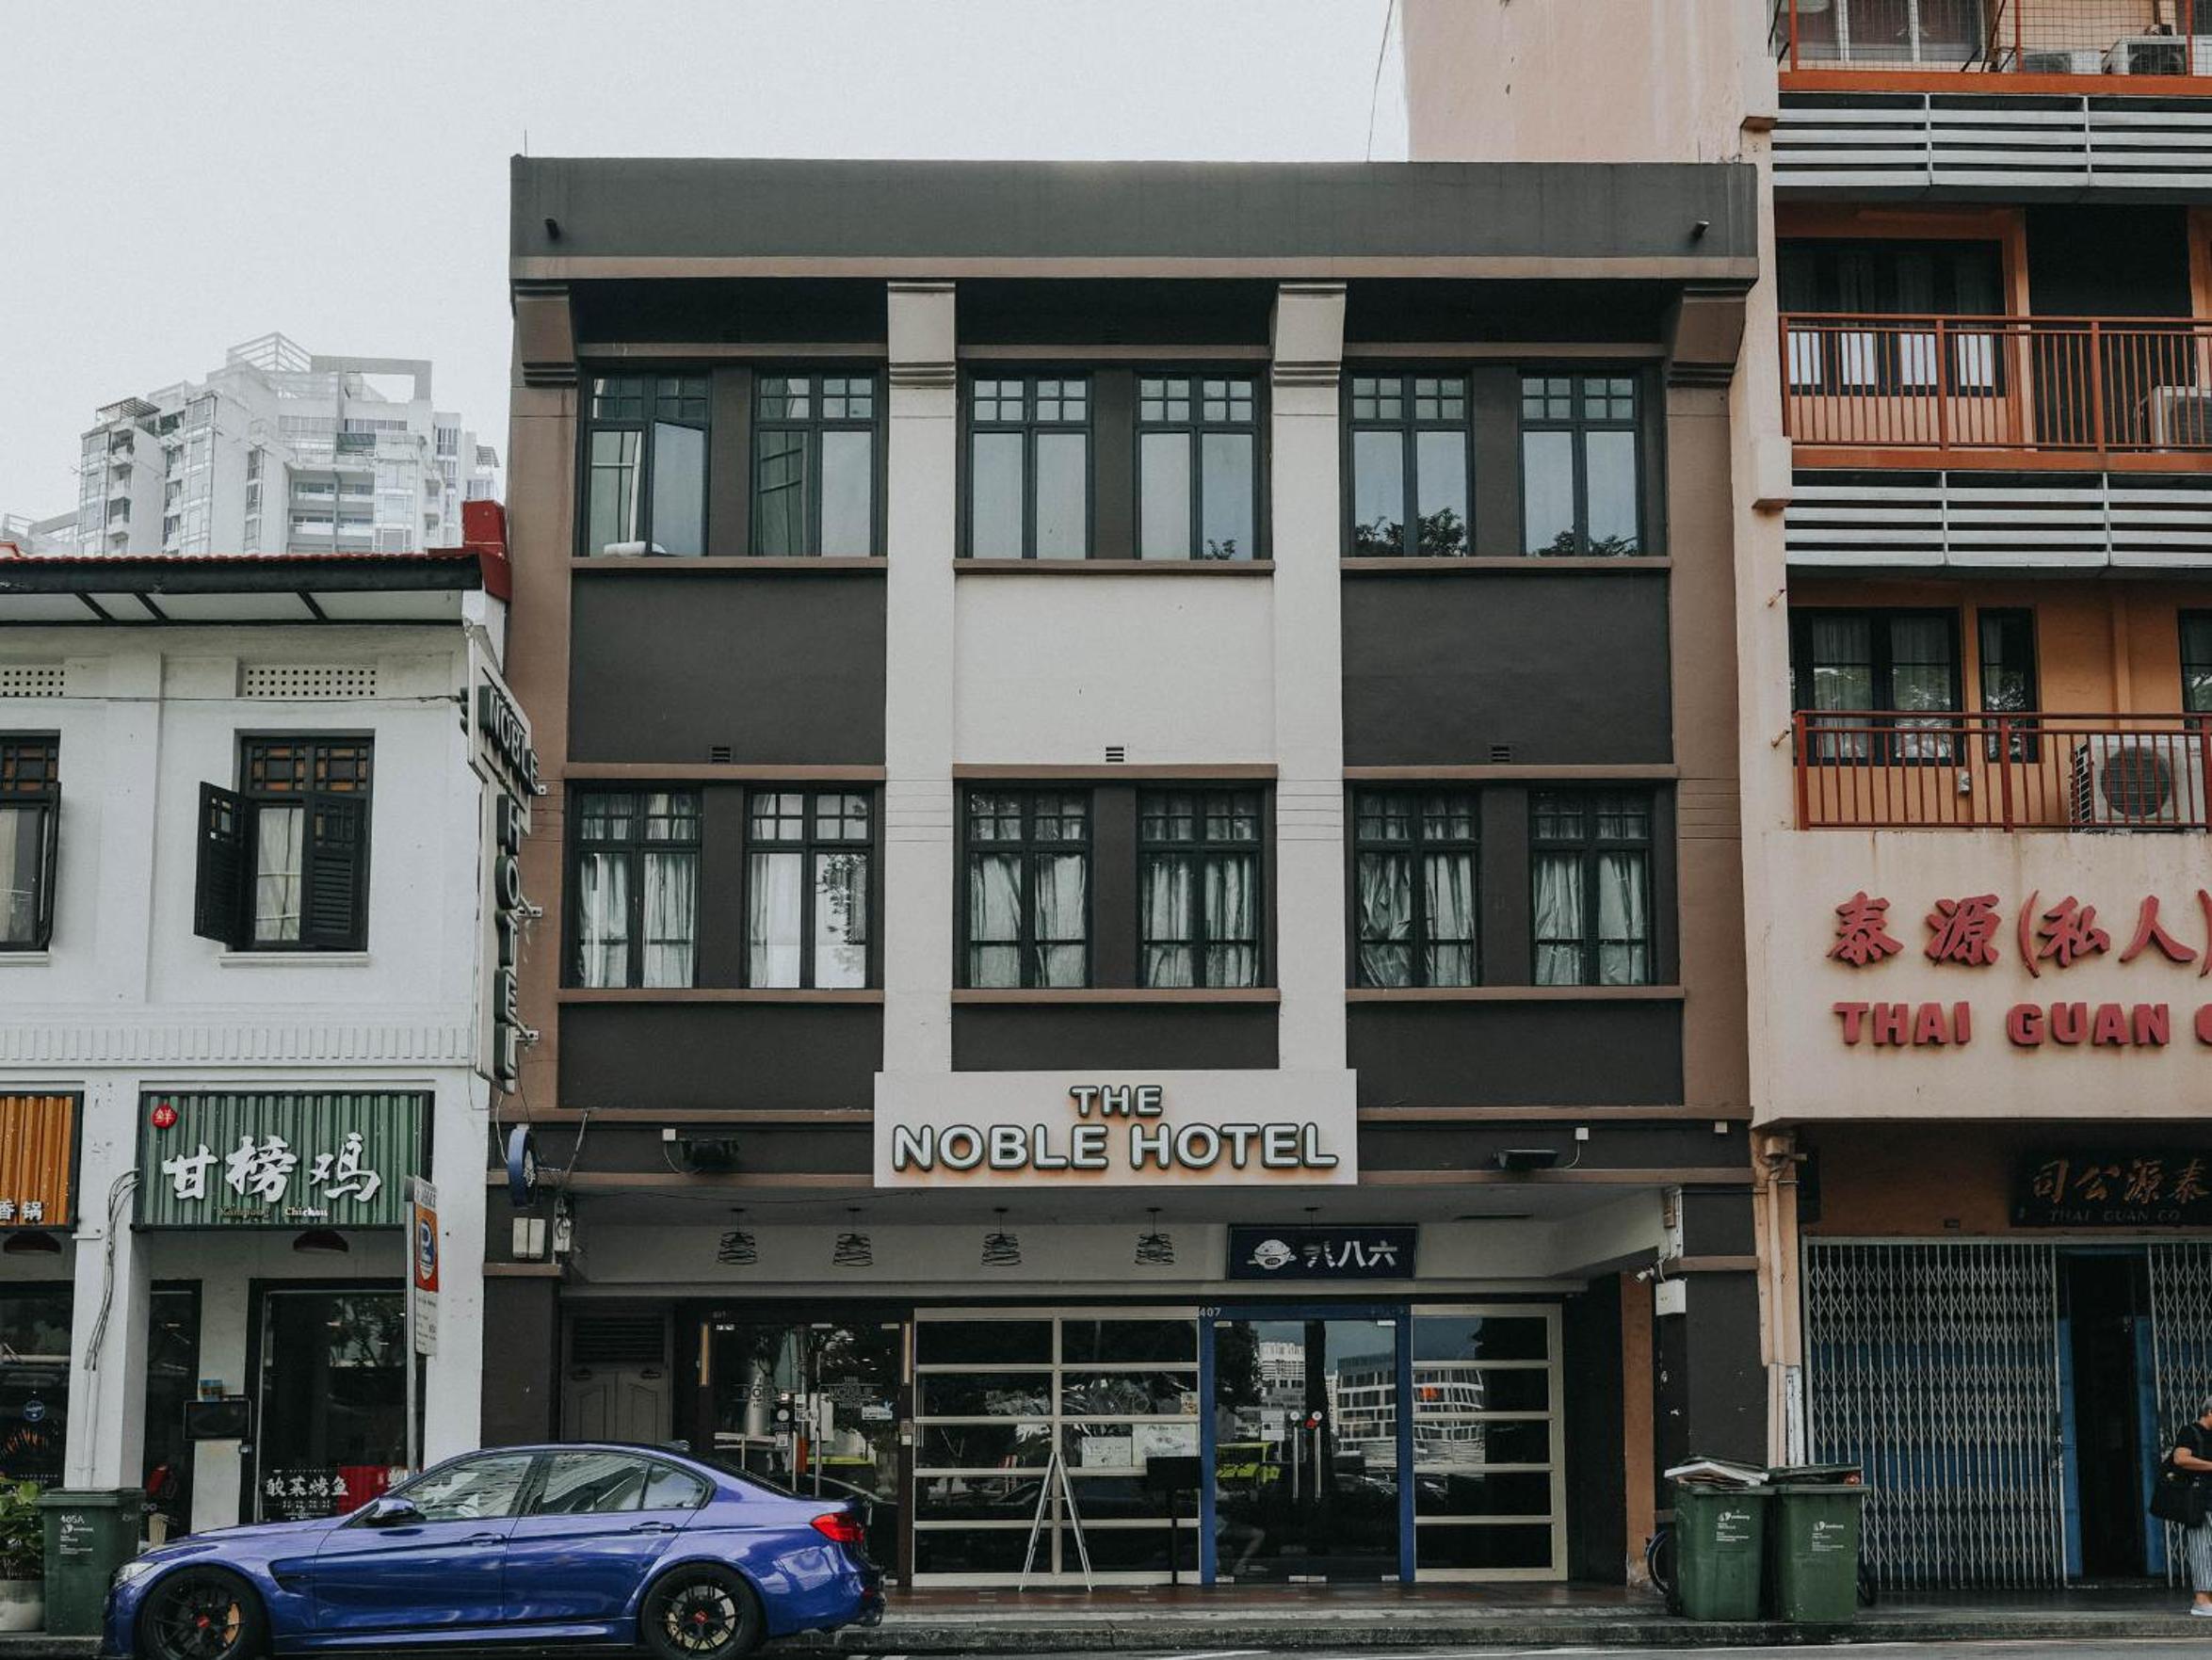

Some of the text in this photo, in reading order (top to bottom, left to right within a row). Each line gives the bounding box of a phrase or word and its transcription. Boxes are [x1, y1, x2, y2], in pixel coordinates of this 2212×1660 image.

[478, 685, 539, 796] NOBLE
[494, 795, 520, 1080] HOTEL
[1833, 1002, 1972, 1045] THAI
[2007, 1002, 2171, 1046] GUAN
[1070, 1085, 1163, 1117] THE
[162, 1132, 381, 1202] 甘榜鸡
[893, 1122, 1339, 1172] NOBLE HOTEL
[2104, 1210, 2149, 1221] GUAN
[1200, 1306, 1222, 1317] 407
